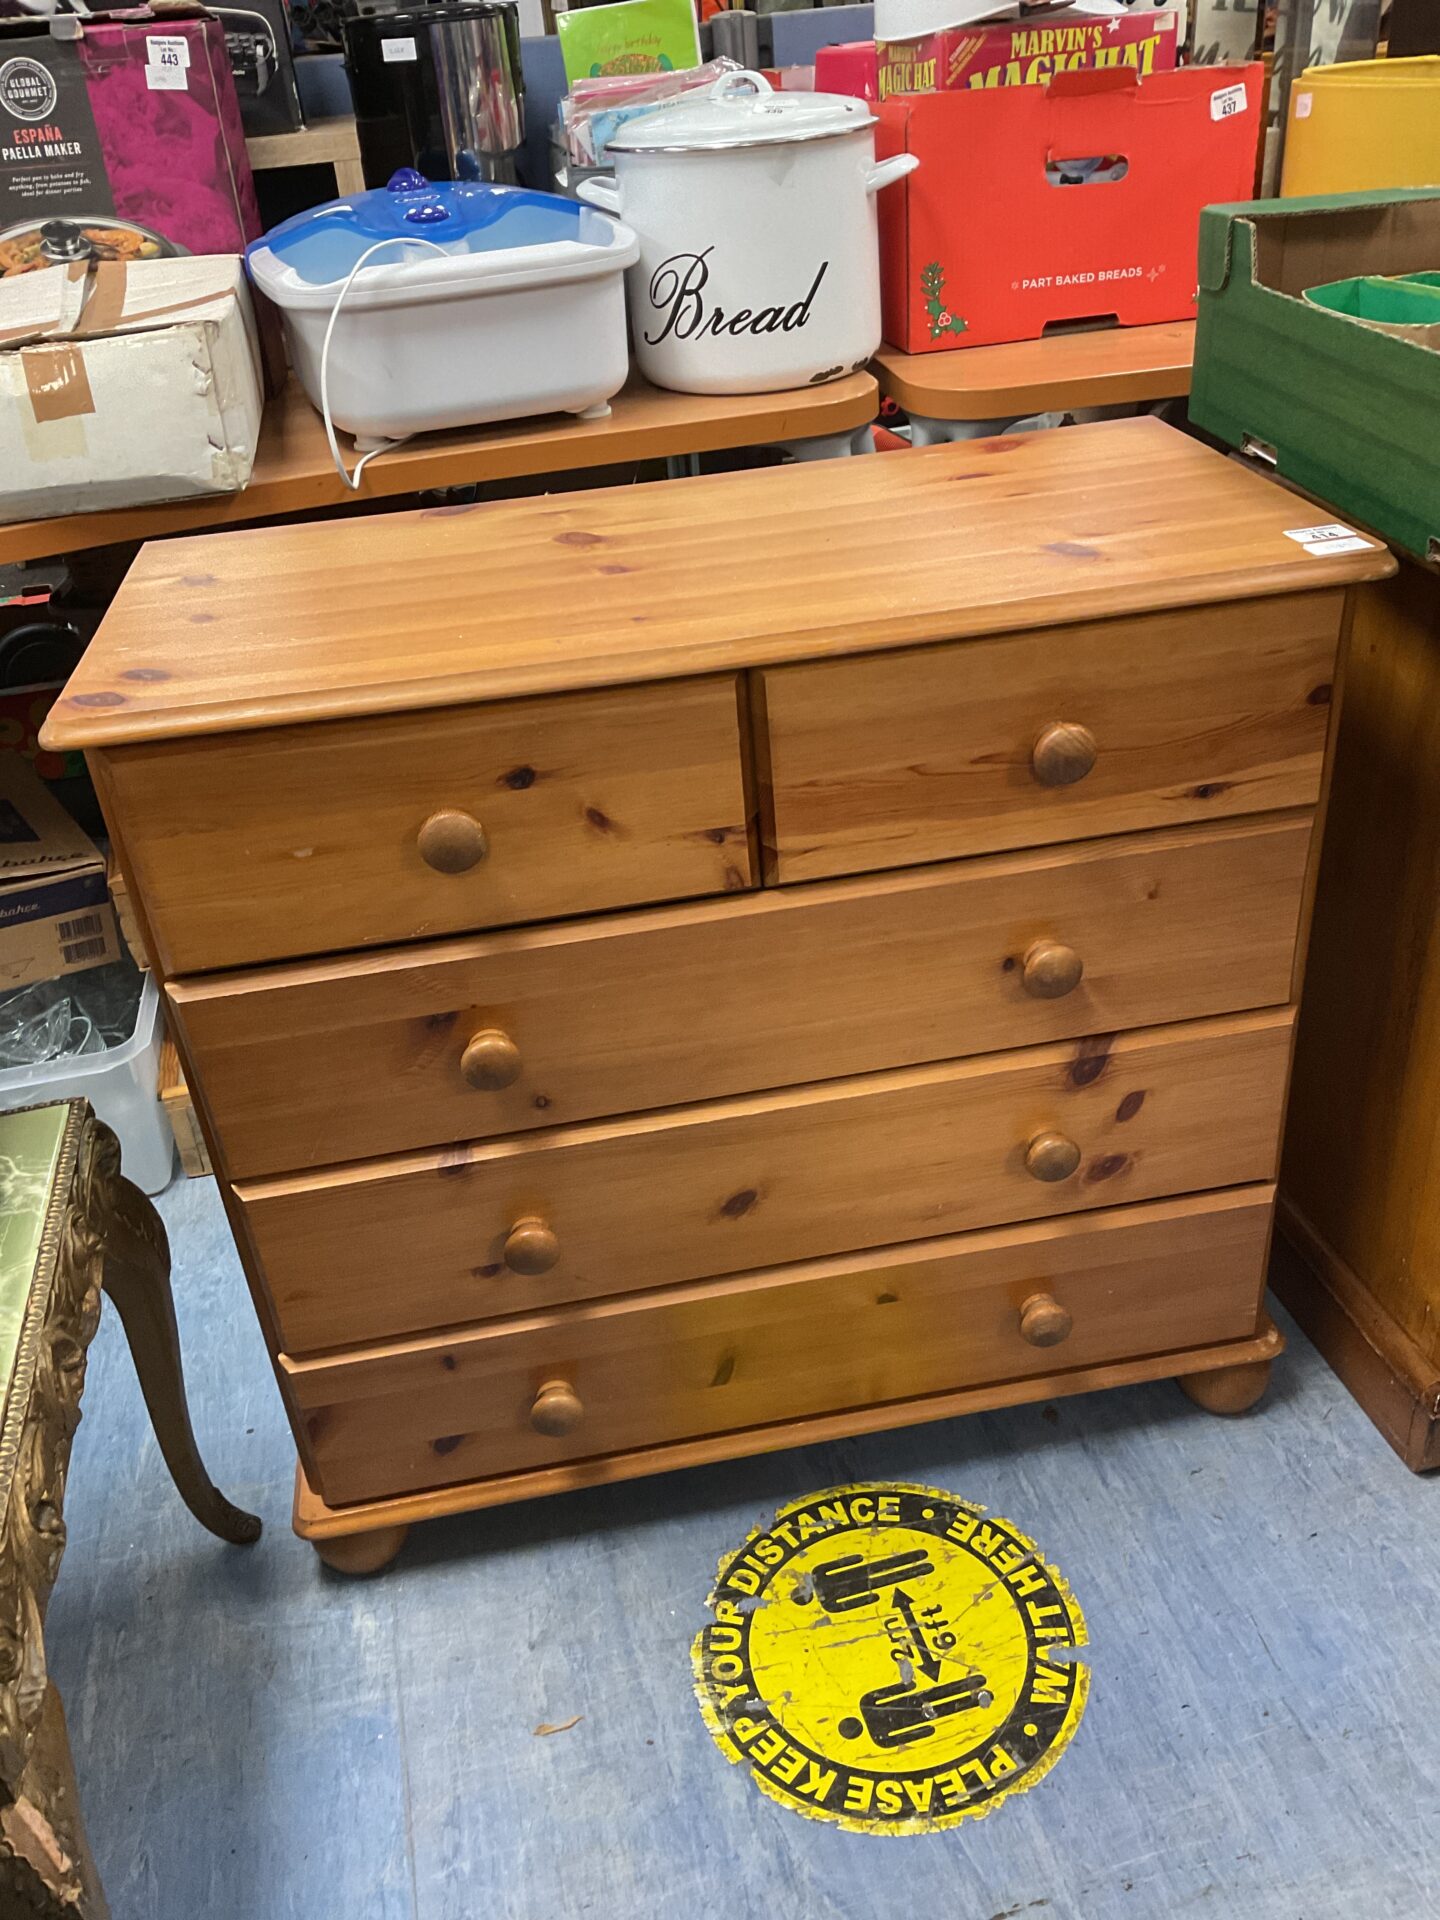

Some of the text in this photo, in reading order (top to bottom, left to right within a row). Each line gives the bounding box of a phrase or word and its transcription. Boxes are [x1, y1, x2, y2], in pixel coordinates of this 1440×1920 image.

[1010, 25, 1103, 59] MARVIN'S
[160, 54, 178, 66] 443
[7, 86, 48, 99] GOURMET
[9, 77, 41, 88] GLOBAL
[878, 62, 912, 102] MAGIC
[913, 57, 937, 91] HAT
[1222, 100, 1236, 115] 437
[13, 124, 63, 145] ESPAÑA
[2, 142, 82, 160] PAELLA MAKER
[1022, 266, 1143, 289] PART BAKED BREADS
[644, 246, 829, 345] Bread
[946, 1511, 1071, 1704] WAIT HERE
[884, 1617, 914, 1663] 2m
[921, 1604, 957, 1650] 6ft
[709, 1496, 1018, 1815] PLEASE KEEP YOUR DISTANCE
